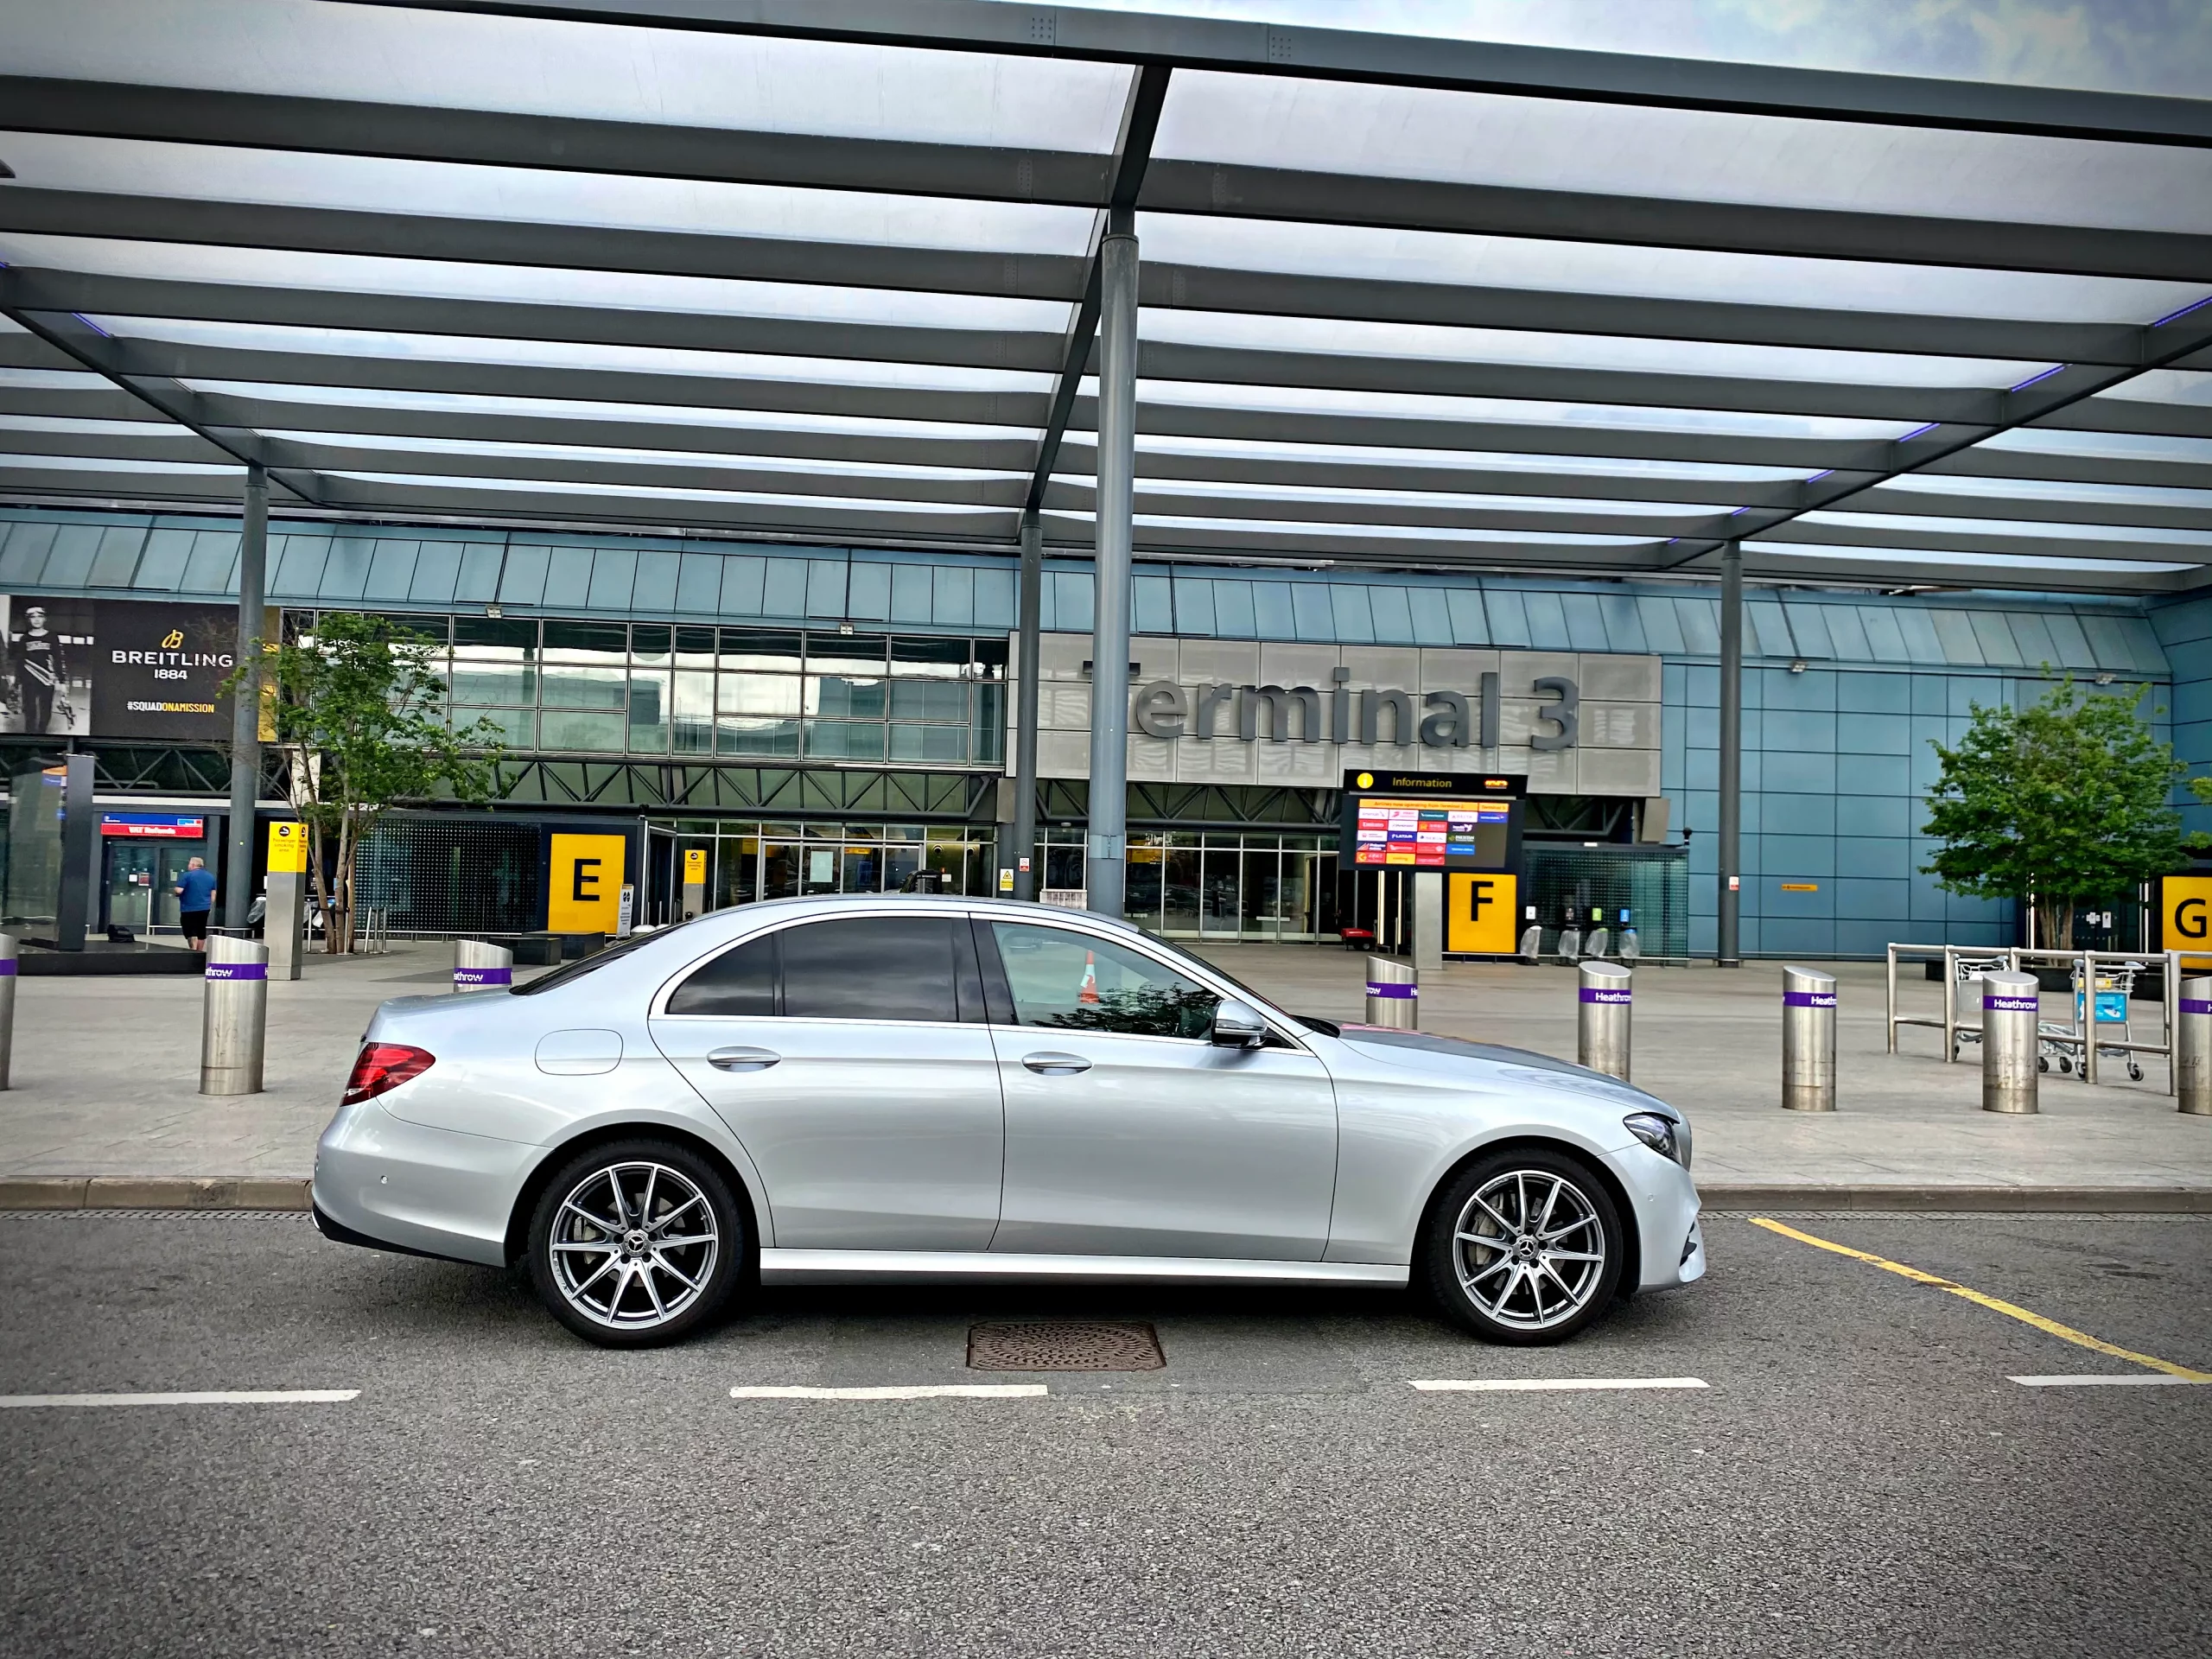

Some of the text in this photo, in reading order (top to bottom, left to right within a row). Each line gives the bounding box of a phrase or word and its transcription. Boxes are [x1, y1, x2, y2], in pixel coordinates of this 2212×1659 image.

[111, 650, 233, 668] BREITLING
[154, 669, 188, 680] 1884
[126, 701, 215, 713] #SQUADONAMISSION
[1530, 677, 1580, 751] 3
[1393, 777, 1452, 788] Information
[573, 858, 601, 901] E
[1471, 880, 1494, 922] F
[2175, 898, 2207, 938] G
[1993, 999, 2037, 1009] Heathrow
